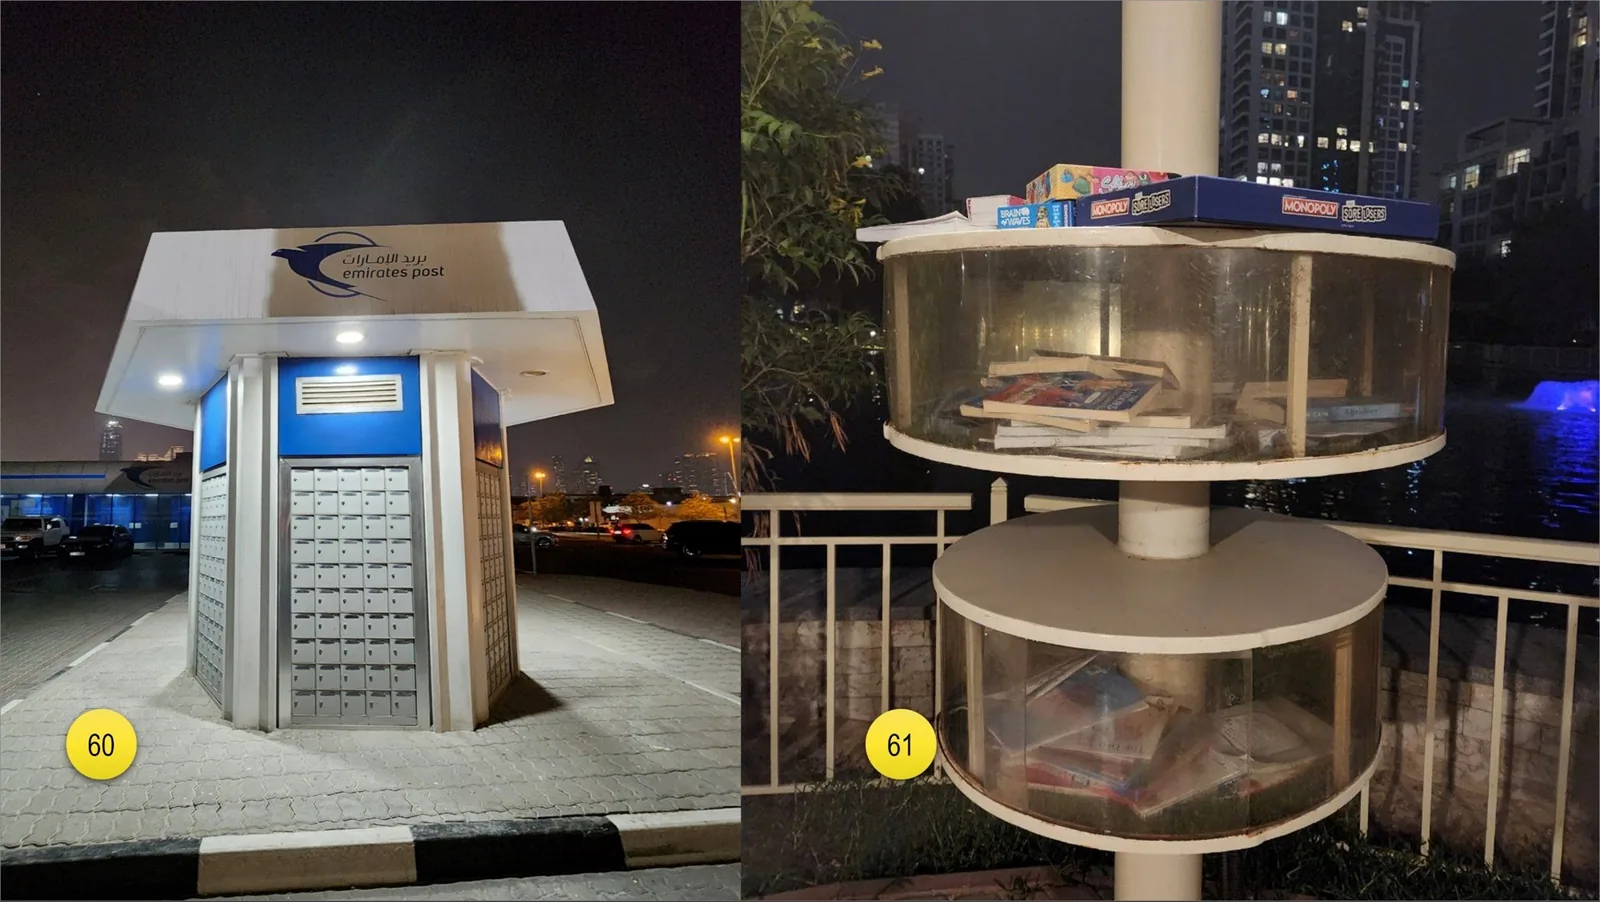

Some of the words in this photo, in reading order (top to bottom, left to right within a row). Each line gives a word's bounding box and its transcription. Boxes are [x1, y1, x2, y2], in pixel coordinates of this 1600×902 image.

[1092, 200, 1128, 216] MONOPOLY
[1133, 198, 1148, 212] SORE
[1148, 193, 1169, 209] LOSERS
[1284, 199, 1337, 215] MONOPOLY
[1344, 208, 1361, 219] SORE
[1363, 207, 1385, 219] LOSERS
[1000, 209, 1021, 218] BRAIN
[1008, 217, 1030, 226] WAVES
[402, 255, 427, 266] بريد
[343, 267, 408, 279] emirates
[412, 266, 445, 279] post
